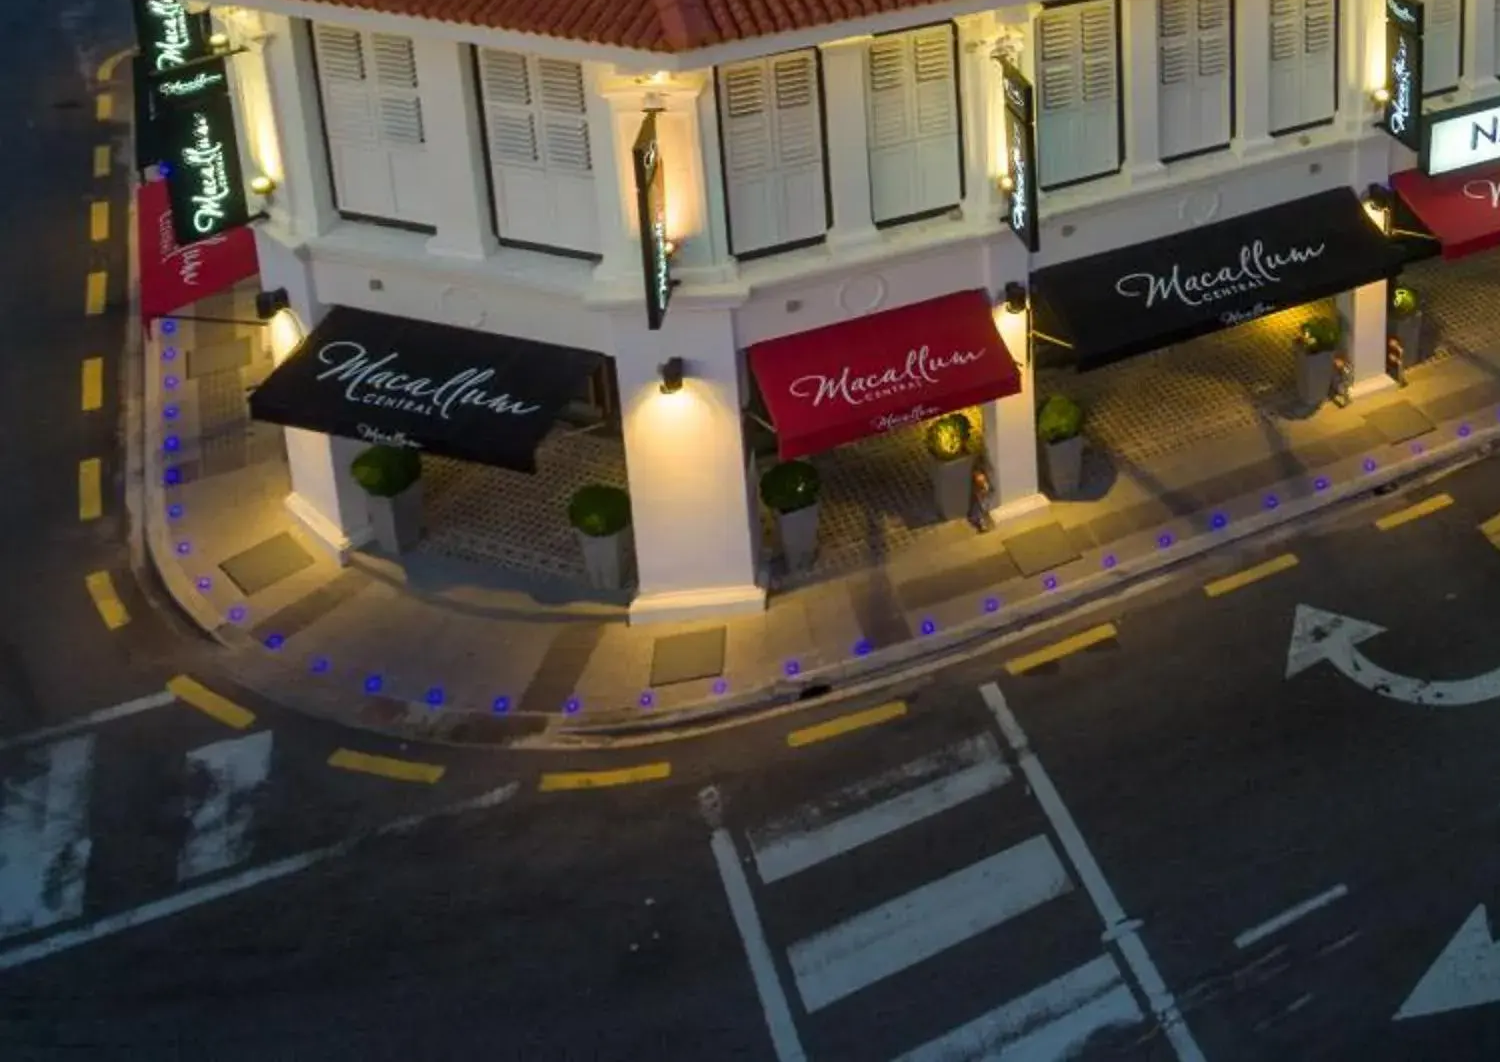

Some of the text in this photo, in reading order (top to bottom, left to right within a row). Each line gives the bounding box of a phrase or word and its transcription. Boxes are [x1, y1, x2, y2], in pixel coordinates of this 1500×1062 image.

[181, 112, 229, 233] Macallum
[1115, 240, 1325, 308] Macallum
[1202, 279, 1265, 301] CENTRAL
[317, 341, 540, 419] Macallum
[362, 393, 432, 415] CENTRAL
[789, 345, 987, 406] Macallum
